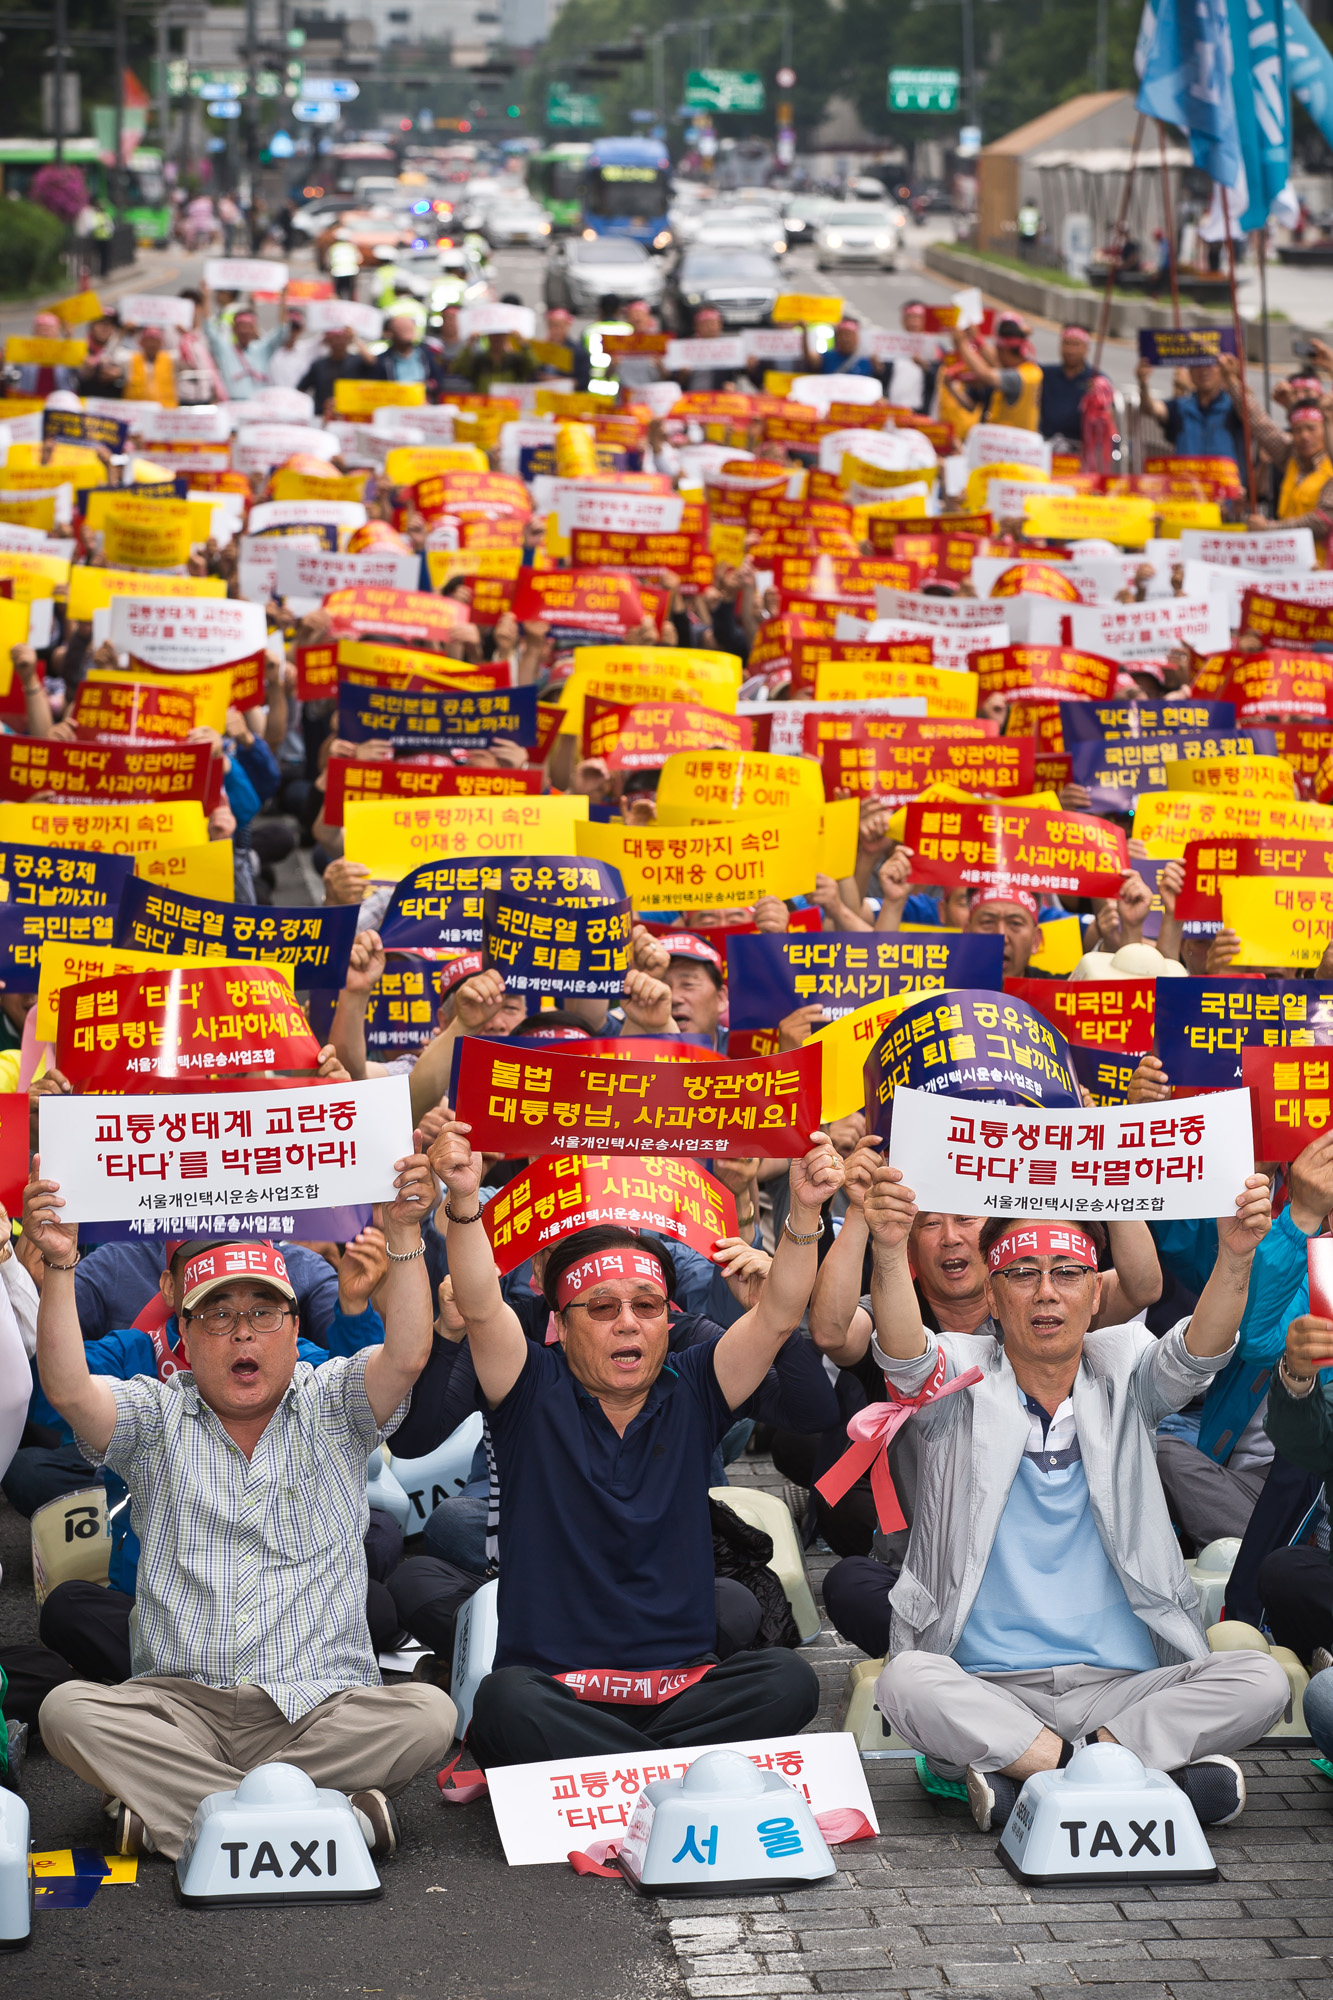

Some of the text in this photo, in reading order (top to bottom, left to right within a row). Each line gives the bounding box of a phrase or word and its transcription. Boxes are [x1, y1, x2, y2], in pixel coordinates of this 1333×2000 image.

[10, 743, 49, 766] 불법
[125, 754, 196, 772] 방관하는
[840, 747, 876, 768] 불법
[948, 745, 1020, 767] 방관하는
[1104, 743, 1179, 767] 국민분열
[97, 773, 193, 794] 사과하세요!
[344, 768, 382, 788] 불법
[456, 775, 527, 795] 방관하는
[32, 814, 174, 835] 대통령까지 속인
[394, 807, 541, 829] 대통령까지 속인
[921, 812, 962, 835] 불법
[1046, 819, 1118, 850] 방관하는
[410, 832, 523, 852] 이재용 OUT!
[624, 829, 780, 859] 대통령까지 속인
[919, 837, 1121, 874] 대통령님, 사과하세요!
[14, 854, 97, 884] 공유경제
[642, 861, 765, 885] 이재용 OUT!
[1197, 848, 1306, 871] 불법 '타다'
[414, 866, 602, 892] 국민분열 공유경제
[146, 895, 322, 941] 국민분열 공유경제
[398, 896, 452, 921] '타다'
[23, 916, 113, 939] 국민분열
[132, 920, 174, 954] '타다'
[496, 906, 578, 944] 국민분열
[532, 947, 581, 972] 퇴출
[783, 943, 950, 970] '타다'는 현대판
[75, 990, 118, 1020] 불법
[226, 979, 299, 1009] 방관하는
[794, 974, 890, 998] 투자사기
[388, 1001, 432, 1024] 퇴출
[1055, 992, 1123, 1016] 대국민
[1201, 992, 1308, 1020] 국민분열
[73, 1009, 312, 1053] 대통령님, 사과하세요!
[879, 1002, 1057, 1070] 국민분열 공유경제
[1075, 1019, 1133, 1043] '타다'
[1184, 1025, 1249, 1055] '타다'
[126, 1049, 276, 1074] 서울개택시운송사업조합
[923, 1034, 977, 1069] 퇴출
[984, 1034, 1072, 1094] 그날까지!
[1273, 1060, 1329, 1091] 불법
[492, 1060, 800, 1100] 불법 '타다' 방관하는
[95, 1100, 358, 1145] 교통생태계 교란종
[489, 1096, 798, 1130] 대통령님, 사과하세요!
[1274, 1098, 1331, 1129] 대통
[551, 1135, 729, 1152] 서울개인택시운송사업조합
[947, 1114, 1206, 1152] 교통생태계 교란종
[97, 1141, 358, 1182] '타다'를 박멸하라!
[947, 1152, 1204, 1188] '타다'를 박멸하라!
[138, 1184, 320, 1211] 서울개인택시운송사업조합
[494, 1179, 531, 1225] 불법
[639, 1156, 724, 1210] 방관하는
[984, 1195, 1165, 1214] 서울개인택시운송사업조합
[129, 1216, 295, 1235] 서울개인택시운송사업조합
[493, 1177, 727, 1249] 대통령님, 사과하세요!
[538, 1206, 688, 1241] 서울개인택시운송사업조합
[225, 1250, 268, 1272] 결단
[990, 1231, 1086, 1265] 정치적 결단
[566, 1256, 663, 1289] 정치적 결단
[408, 1478, 466, 1519] TA
[564, 1673, 652, 1698] 택시규제
[1060, 1819, 1176, 1858] TAXI
[221, 1839, 338, 1879] TAXI
